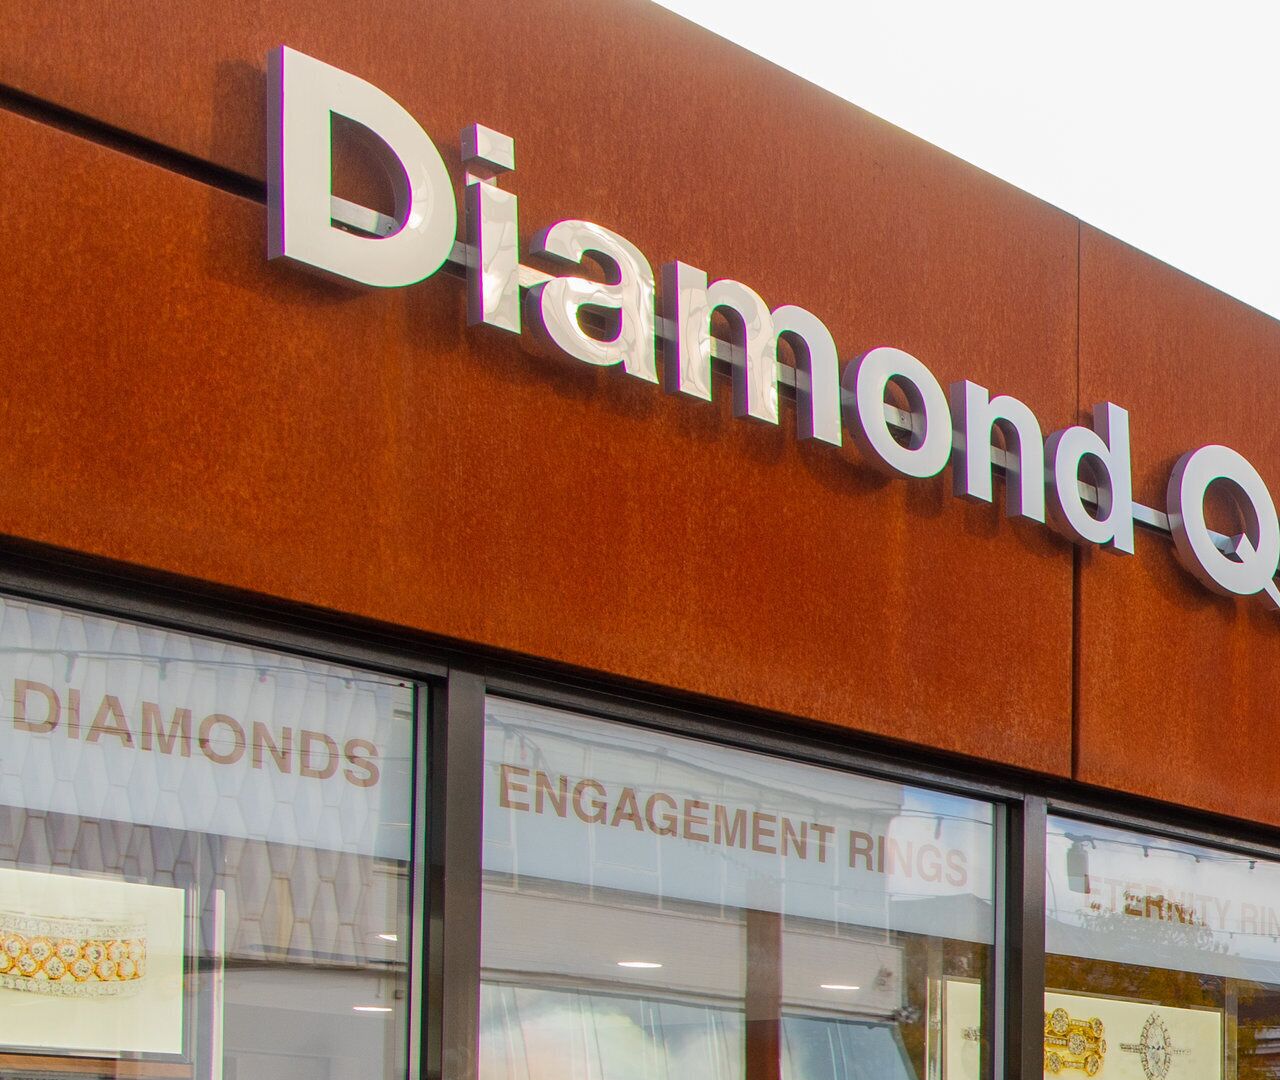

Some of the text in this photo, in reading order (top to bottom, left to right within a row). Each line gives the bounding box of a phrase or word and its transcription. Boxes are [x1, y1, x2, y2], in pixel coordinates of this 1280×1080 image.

[267, 45, 1134, 554] Diamond
[12, 678, 382, 789] DIAMONDS
[497, 763, 970, 888] ENGAGEMENT RINGS
[1084, 874, 1232, 930] ETERNITY
